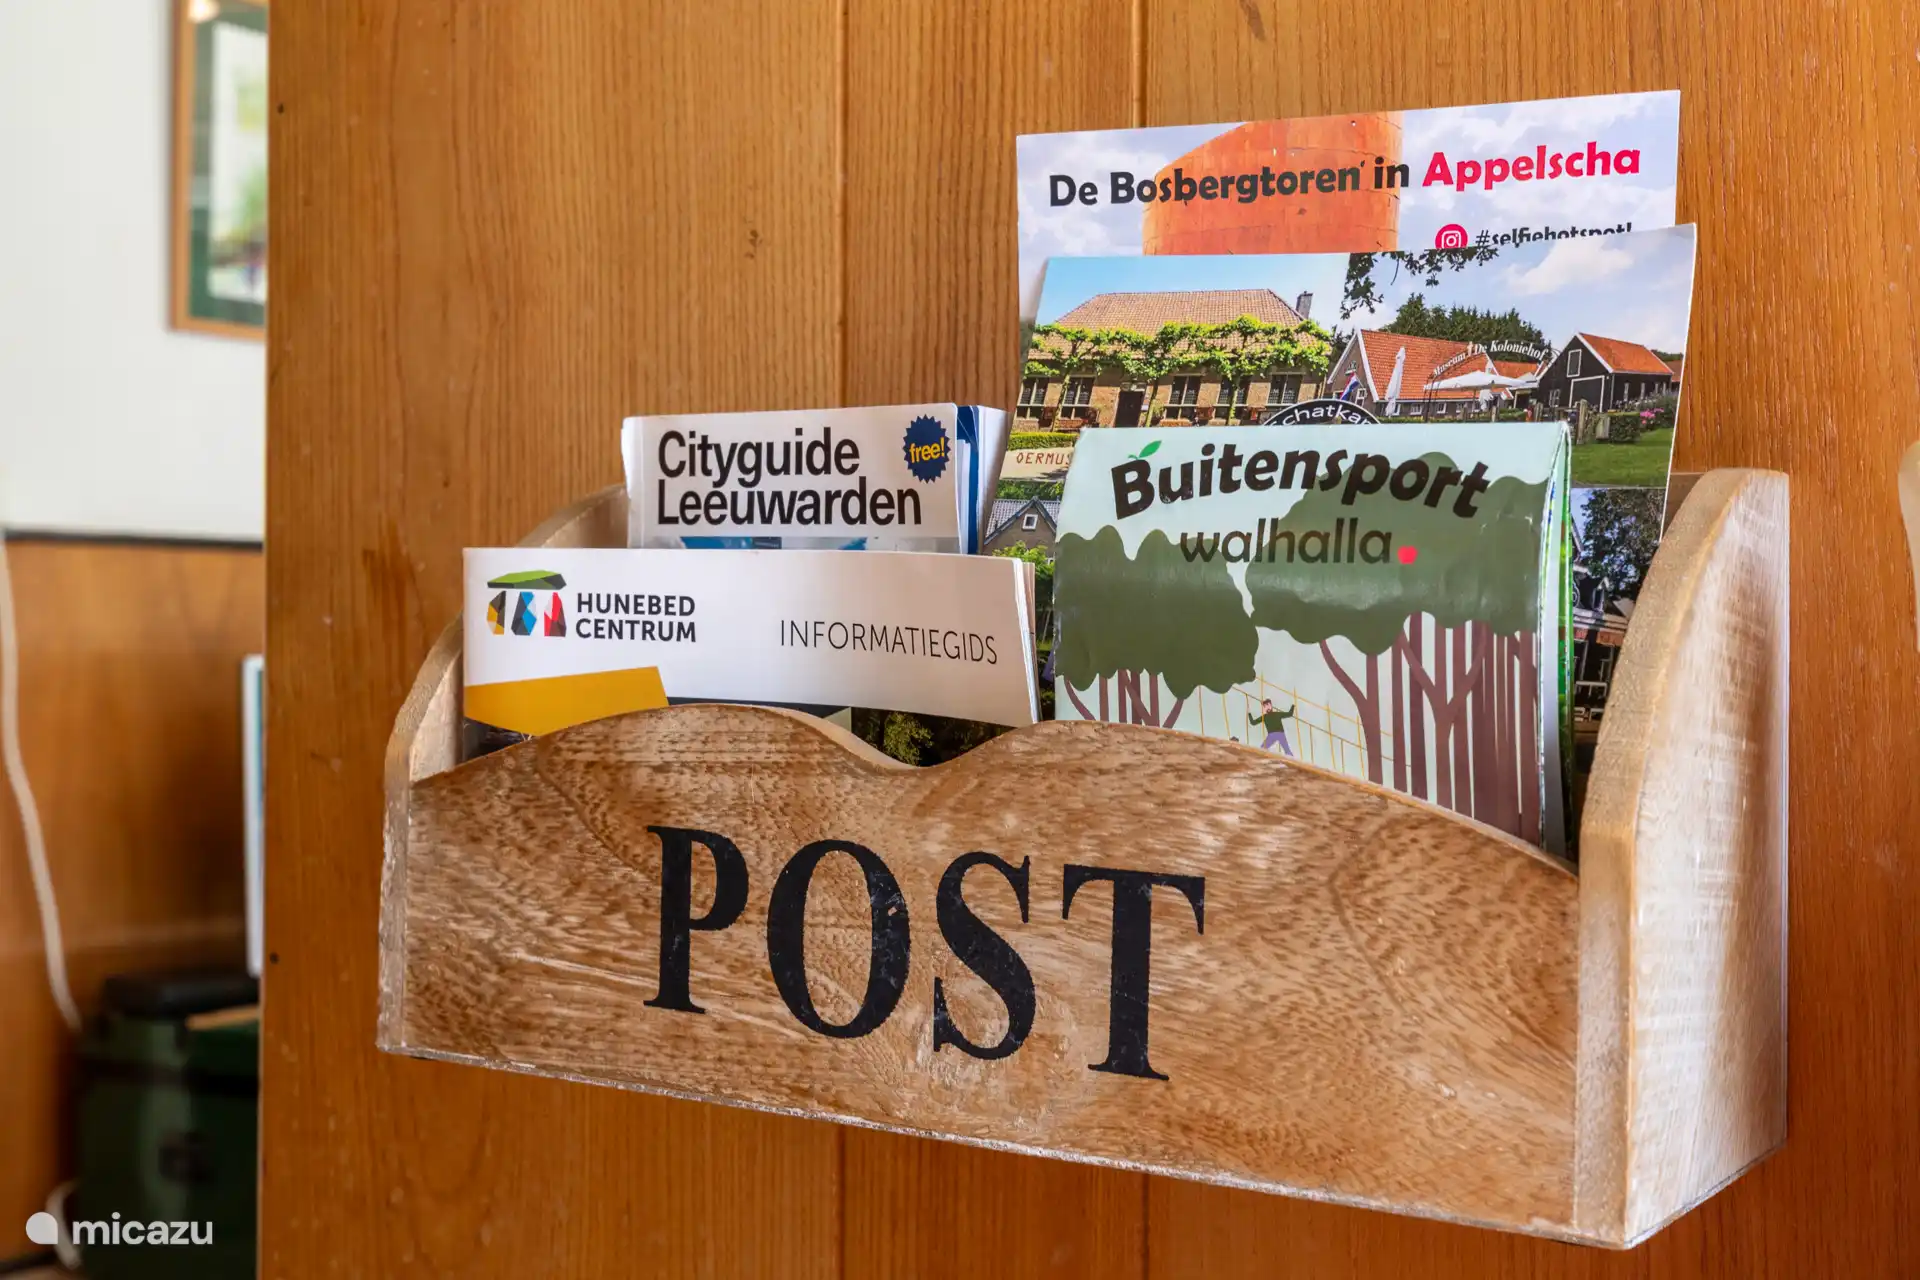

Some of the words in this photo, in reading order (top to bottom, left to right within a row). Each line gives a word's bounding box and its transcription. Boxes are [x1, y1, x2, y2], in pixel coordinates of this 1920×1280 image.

[1049, 172, 1098, 208] De
[1110, 165, 1361, 205] Bosbergtoren
[1374, 155, 1410, 190] in
[1422, 141, 1641, 192] Appelscha
[658, 427, 860, 488] Cityguide
[909, 437, 945, 464] free!
[658, 476, 922, 526] Leeuwarden
[1111, 443, 1490, 520] Buitensport
[577, 592, 696, 617] HUNEBED
[575, 618, 697, 643] CENTRUM
[780, 619, 999, 666] INFORMATIEGIDS
[643, 825, 1206, 1081] POST
